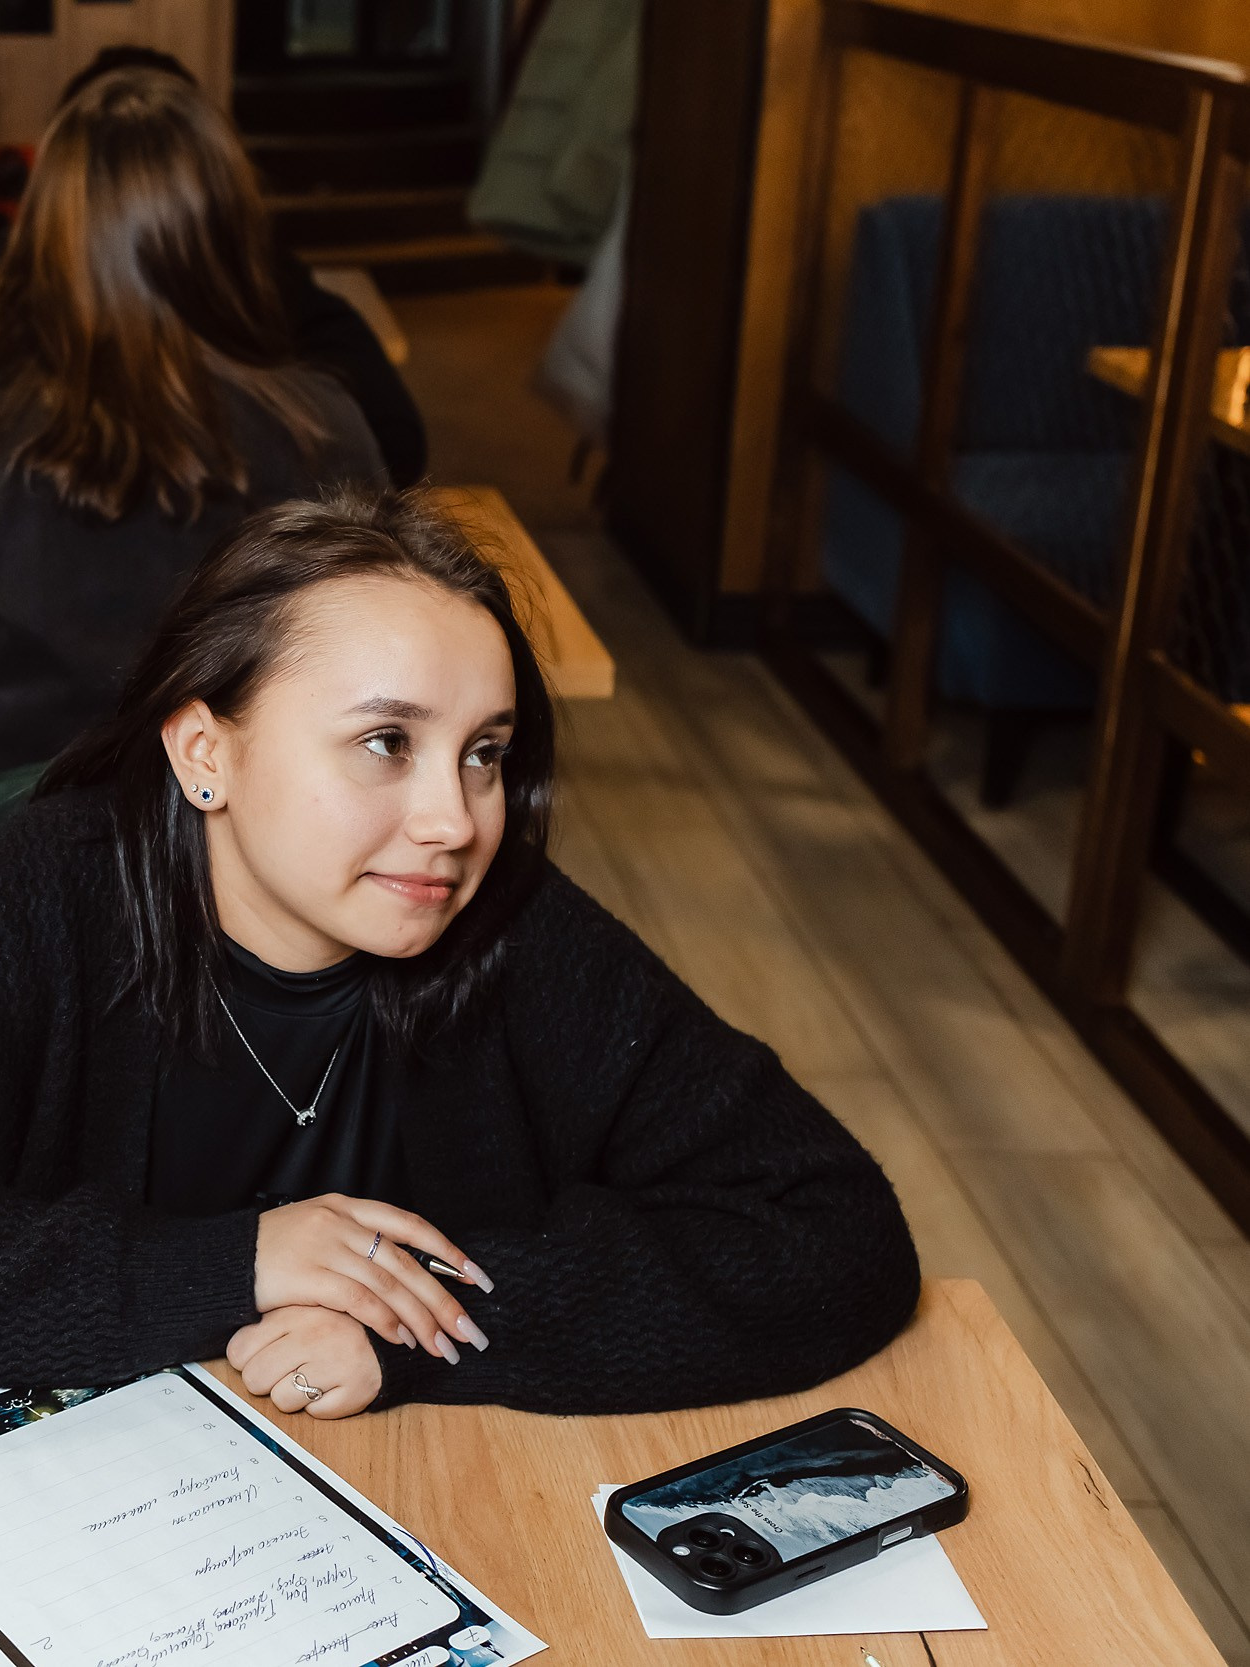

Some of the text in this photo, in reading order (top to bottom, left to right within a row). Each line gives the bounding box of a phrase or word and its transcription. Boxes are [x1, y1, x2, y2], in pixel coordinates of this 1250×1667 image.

[751, 1508, 764, 1518] the
[762, 1517, 783, 1533] Cross
[29, 1635, 53, 1650] 2
